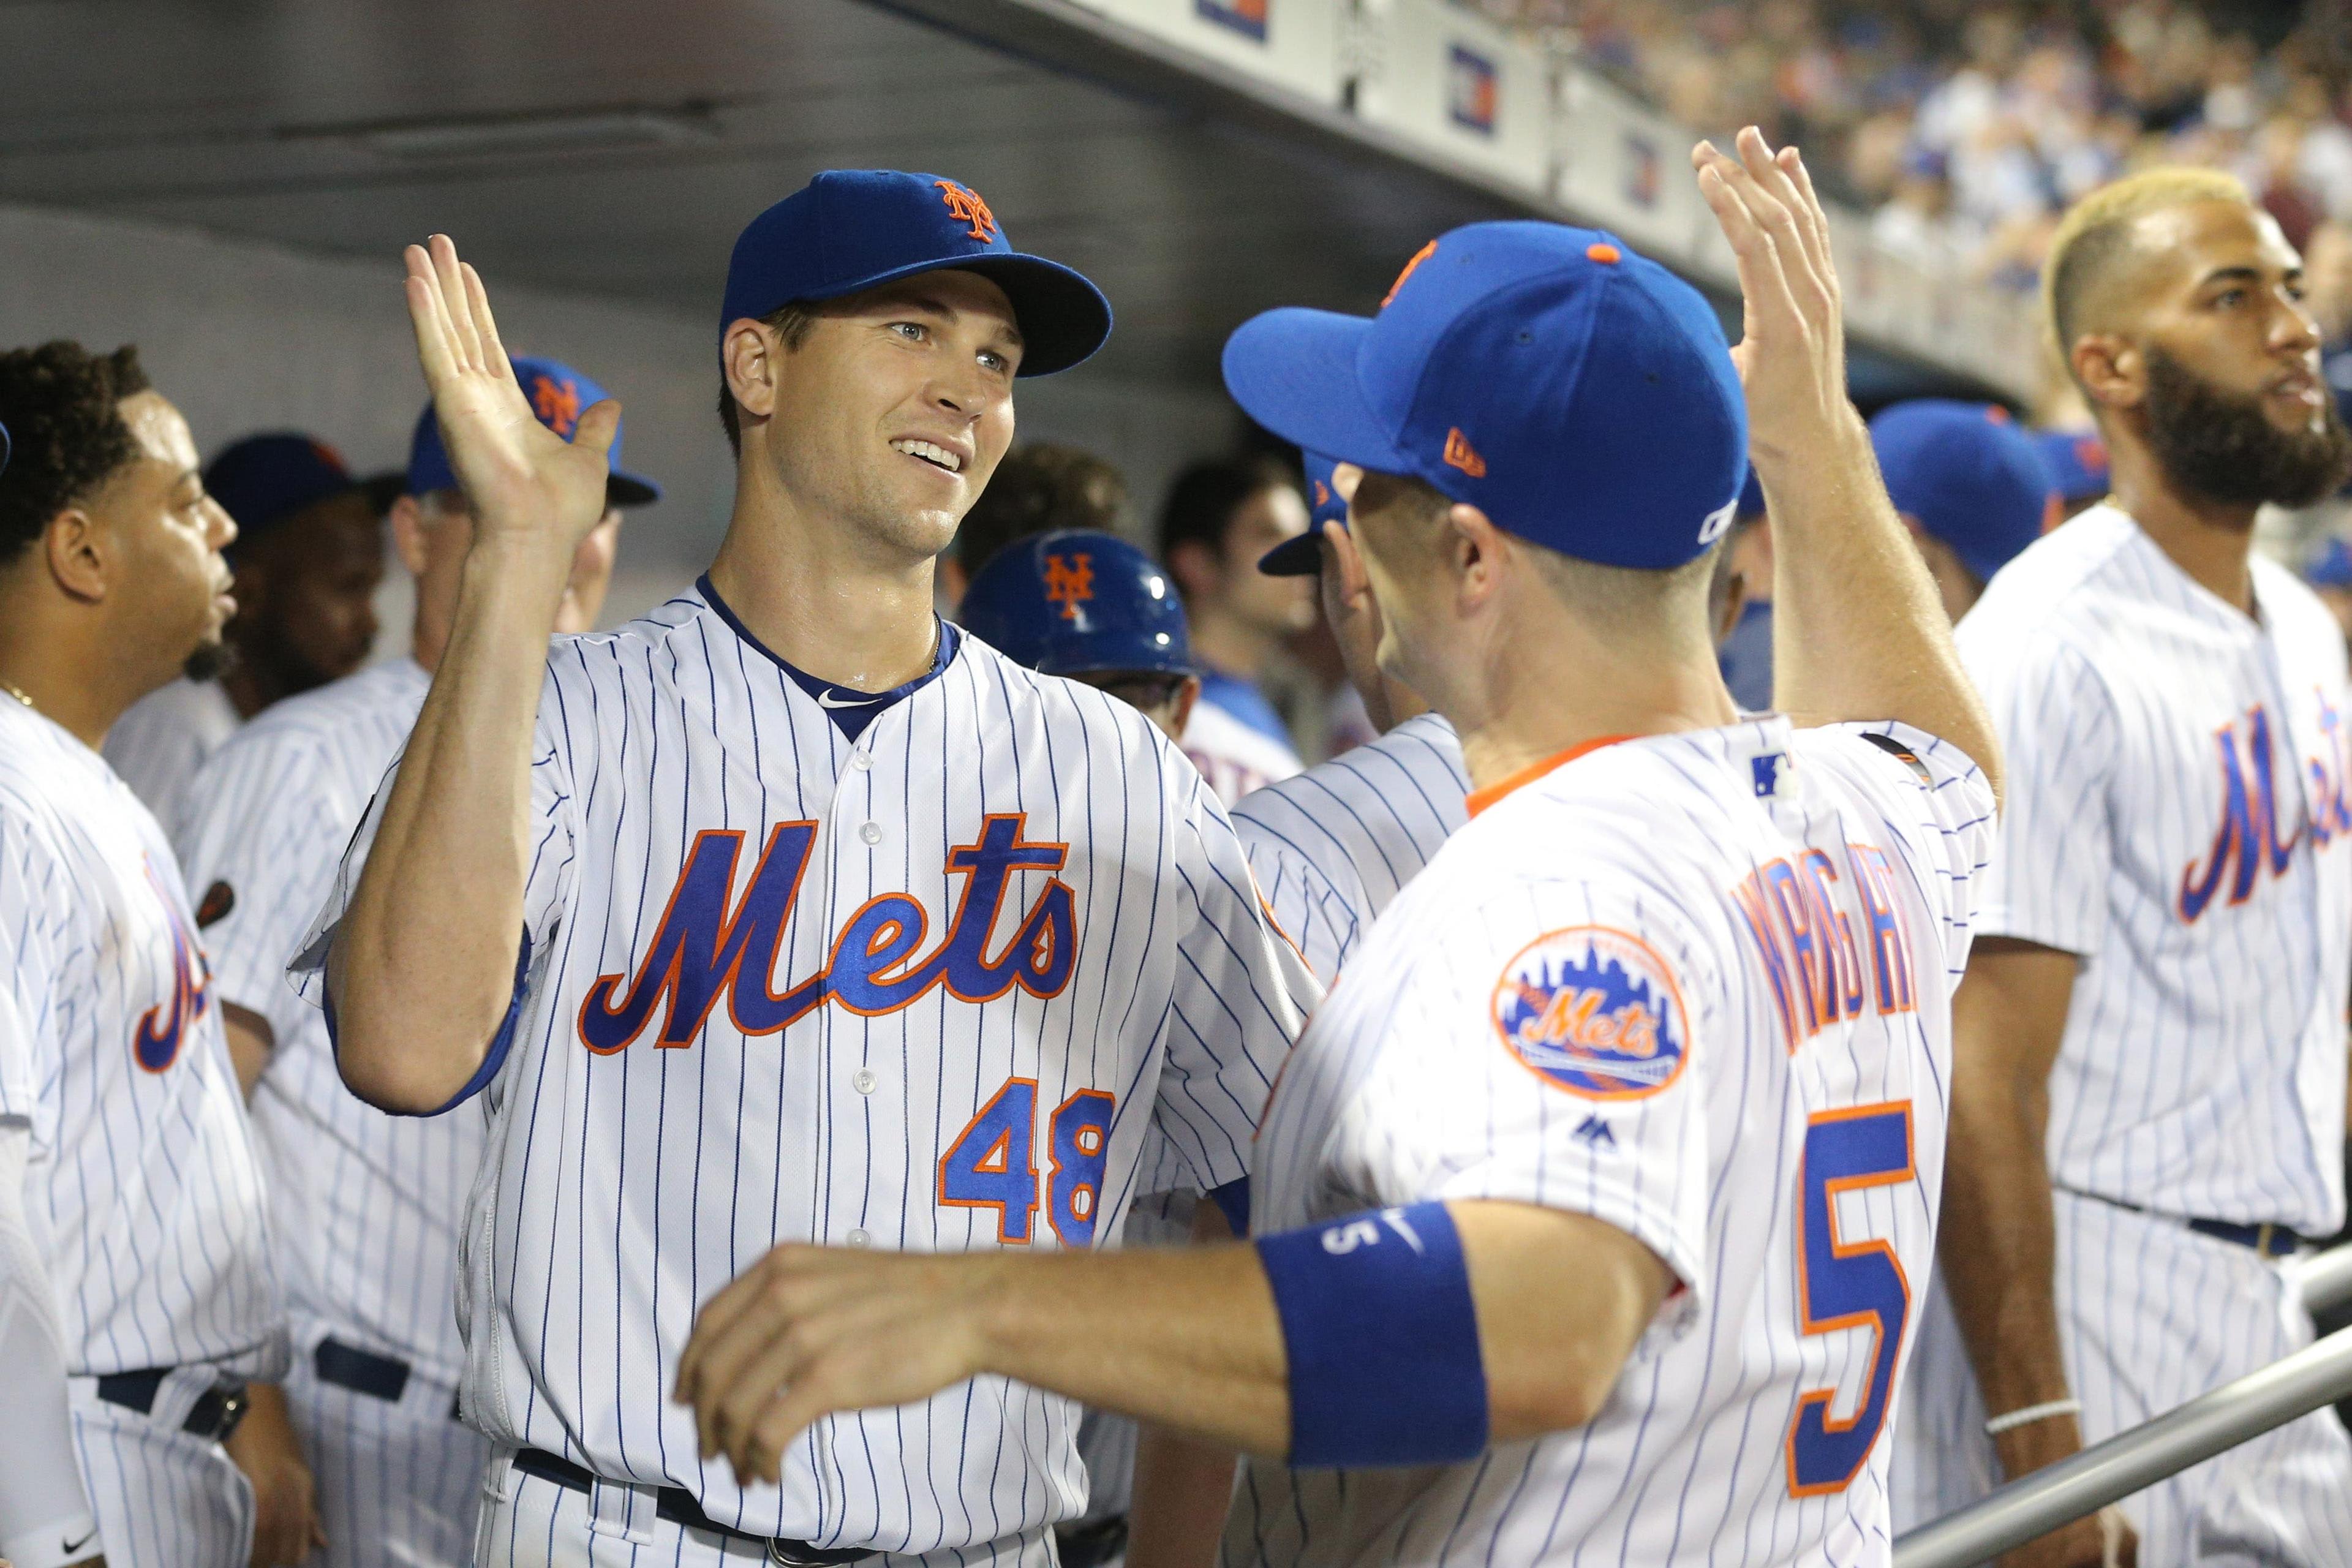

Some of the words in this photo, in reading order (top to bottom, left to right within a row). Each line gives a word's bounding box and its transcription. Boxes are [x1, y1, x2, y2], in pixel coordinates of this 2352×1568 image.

[934, 181, 997, 244] NY
[1043, 552, 1095, 619] NY
[577, 813, 1077, 1056] Mets
[1519, 985, 1657, 1059] Mets
[938, 1076, 1116, 1250] 48
[1321, 1220, 1381, 1255] 5
[1786, 1099, 1915, 1499] 5
